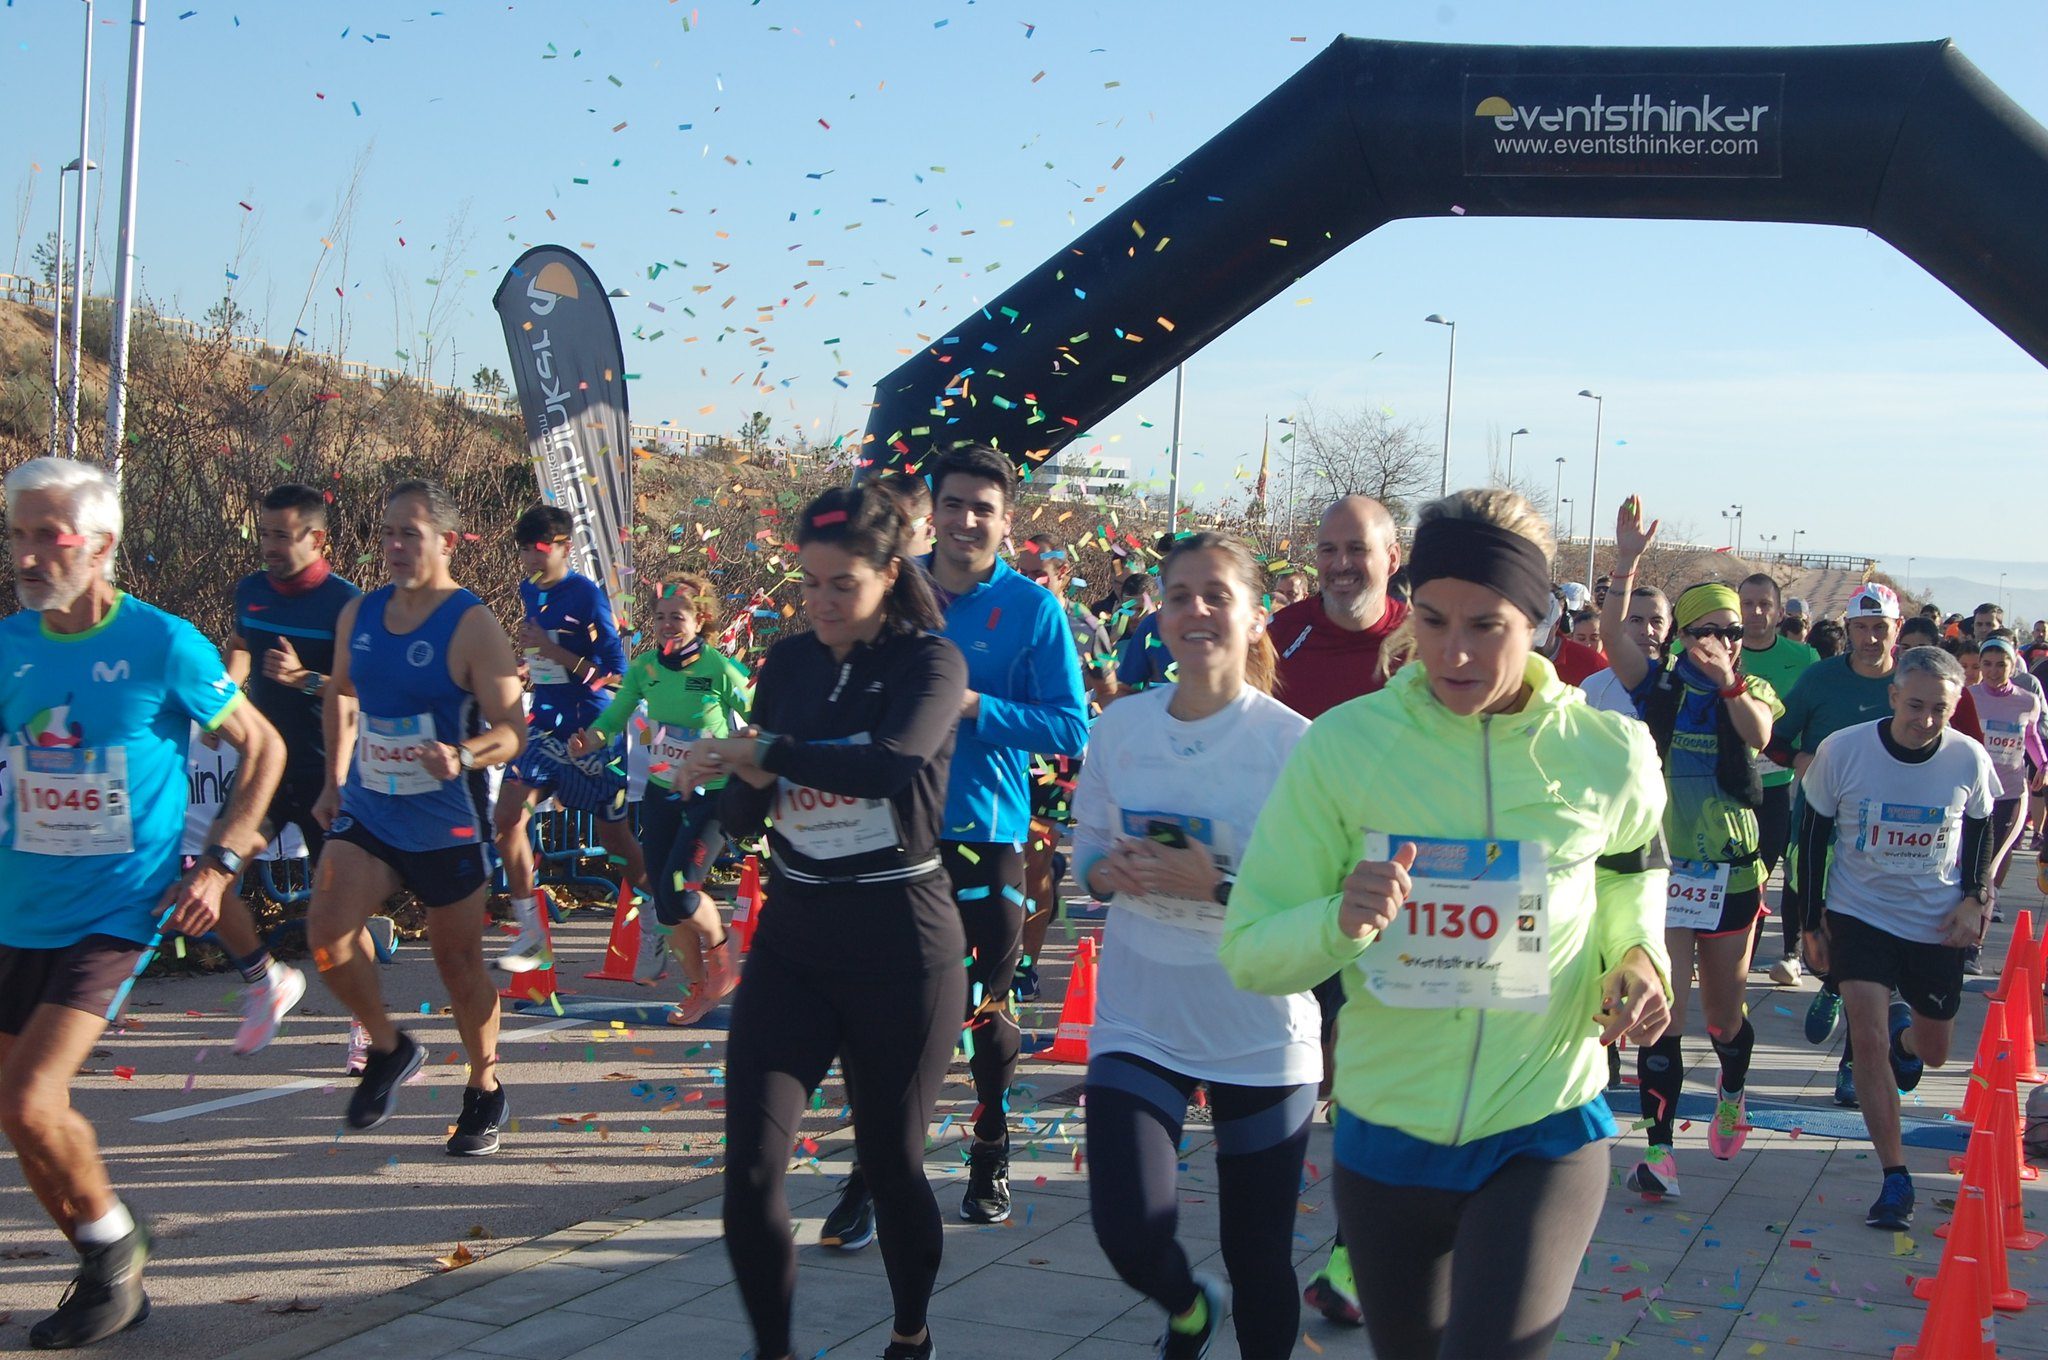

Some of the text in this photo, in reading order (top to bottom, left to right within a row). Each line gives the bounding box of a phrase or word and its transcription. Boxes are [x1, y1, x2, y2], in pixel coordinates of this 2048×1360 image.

[1494, 94, 1769, 132] eventsthinker
[1494, 134, 1759, 155] www.eventsthinker.com
[1988, 736, 2016, 748] 1062
[369, 744, 418, 762] 1040
[32, 787, 101, 811] 1046
[1887, 830, 1932, 847] 1140
[1667, 883, 1707, 902] 043
[1403, 901, 1499, 940] 1130
